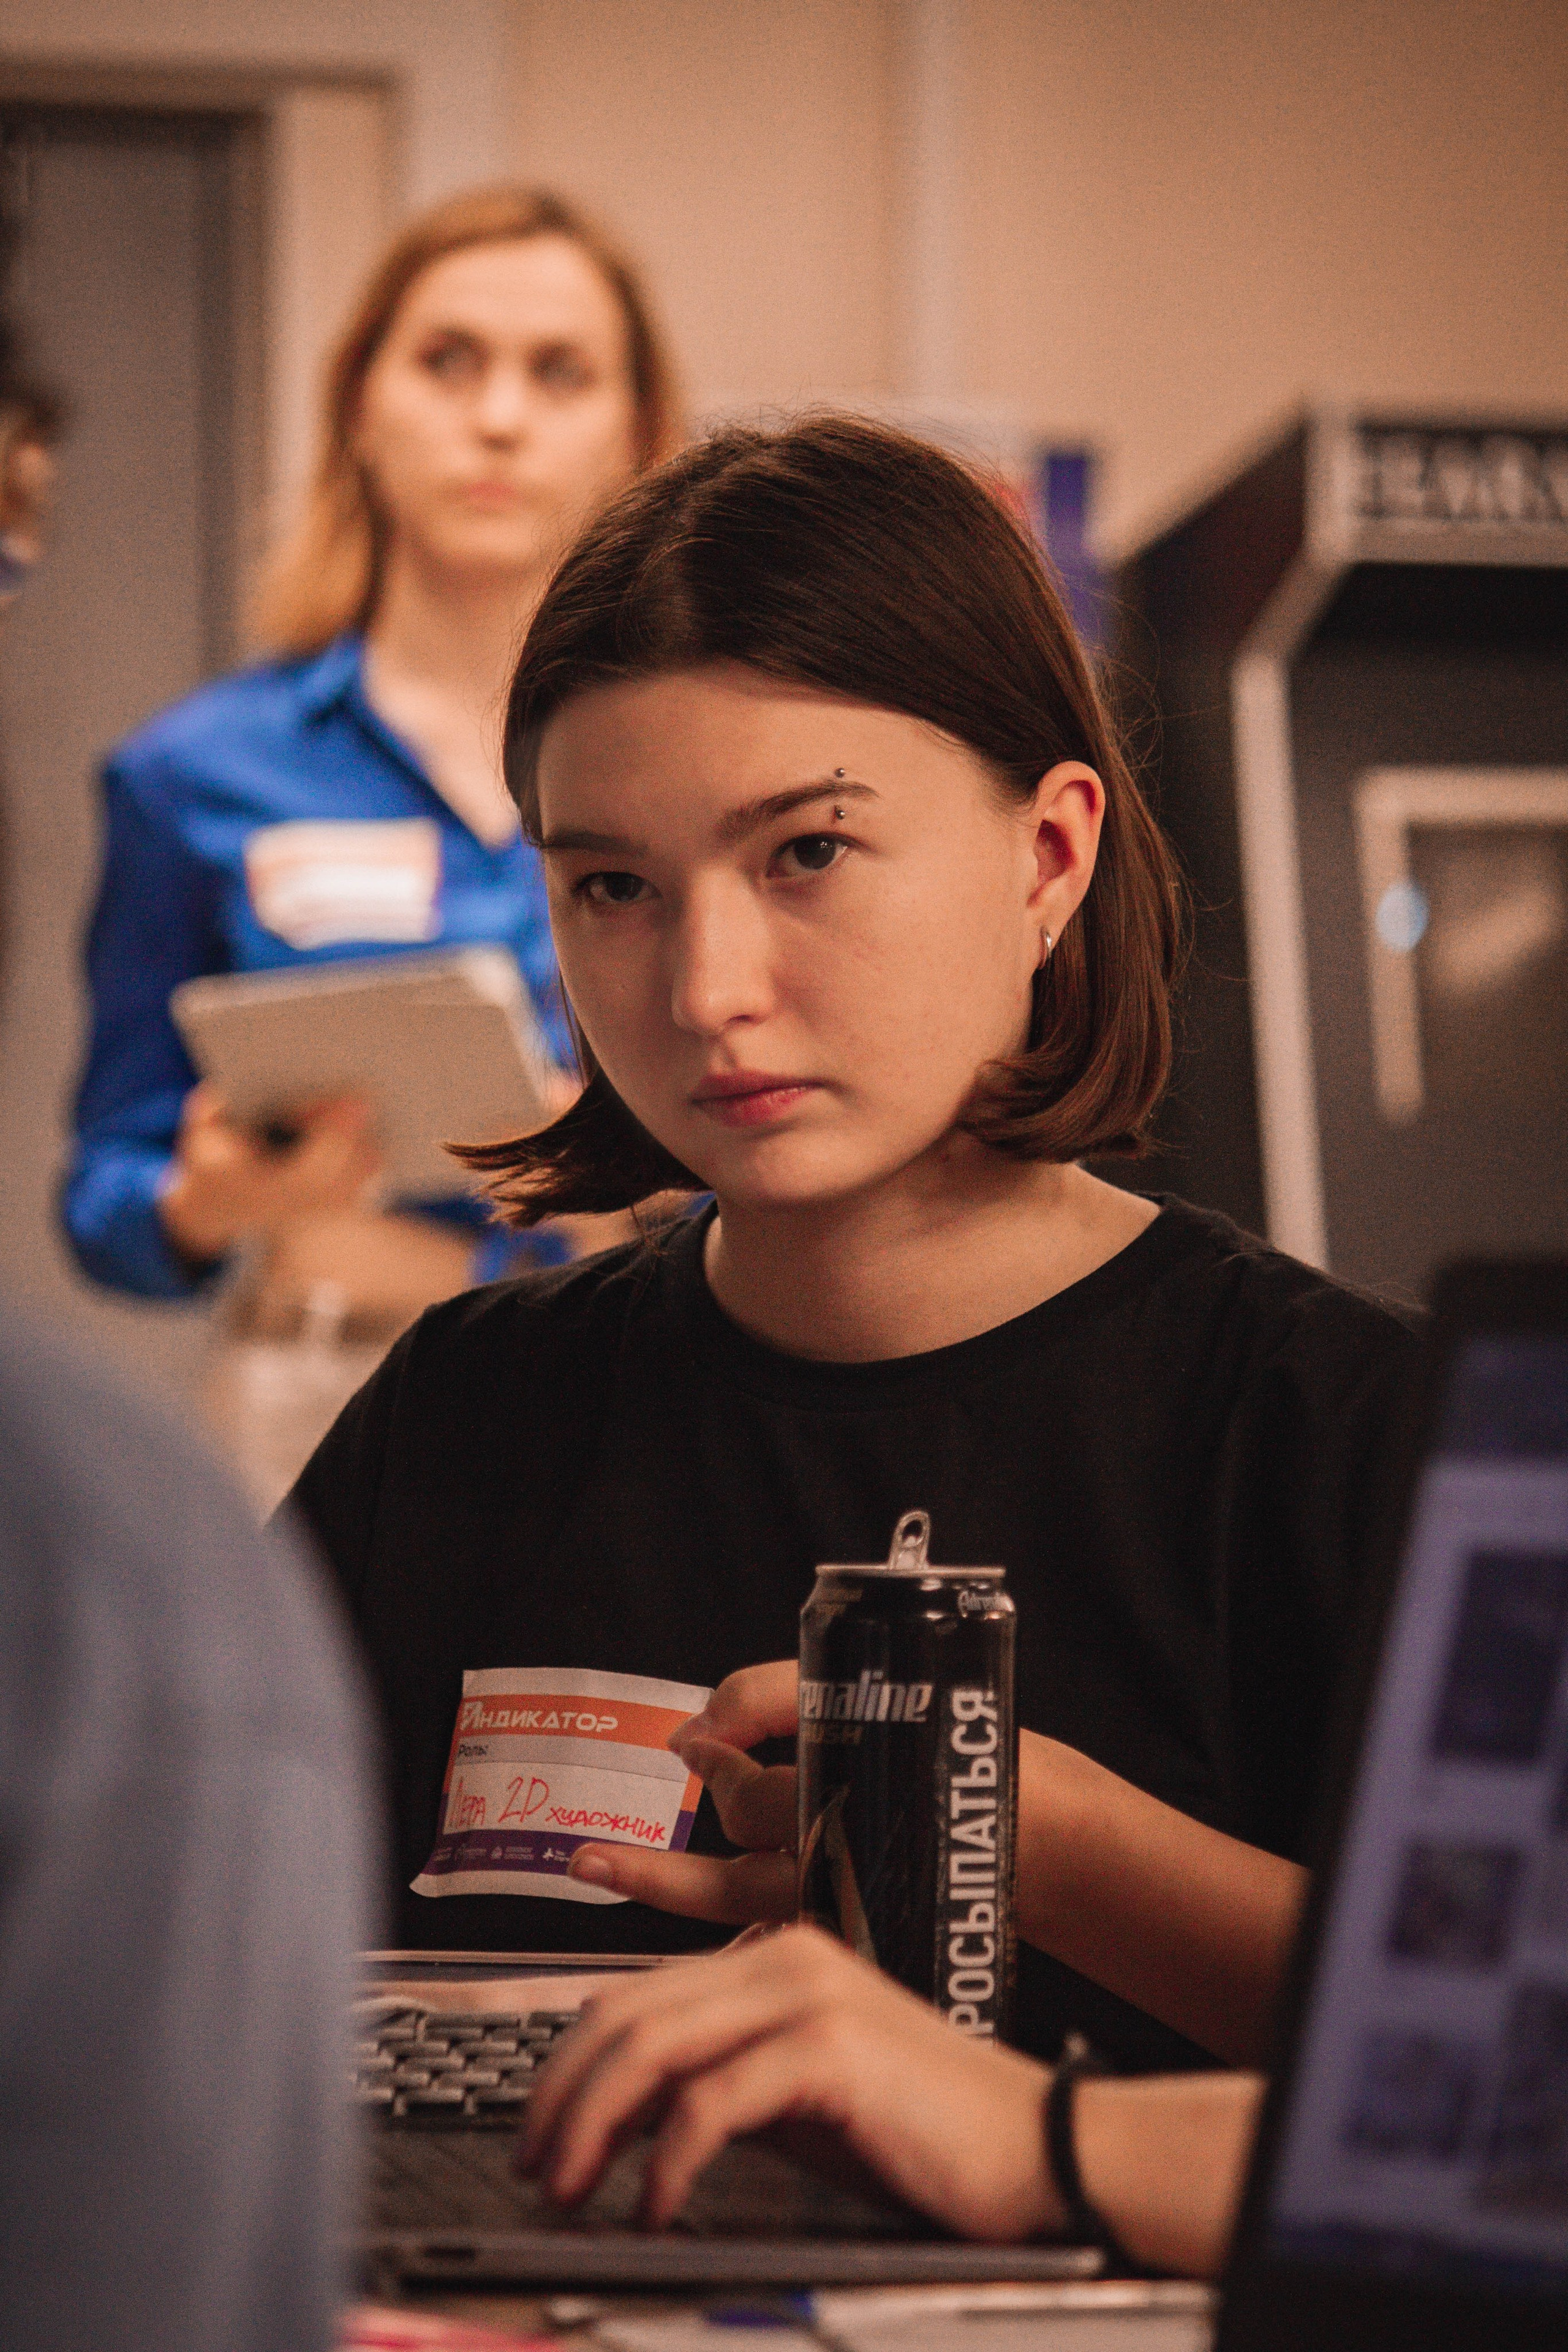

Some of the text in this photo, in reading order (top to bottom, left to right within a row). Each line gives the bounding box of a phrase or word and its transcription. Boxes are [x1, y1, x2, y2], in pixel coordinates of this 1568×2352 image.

[799, 1670, 933, 1722] enaline
[497, 1776, 549, 1823] 2D
[948, 1689, 998, 2048] РОСЫПАТЬСЯ
